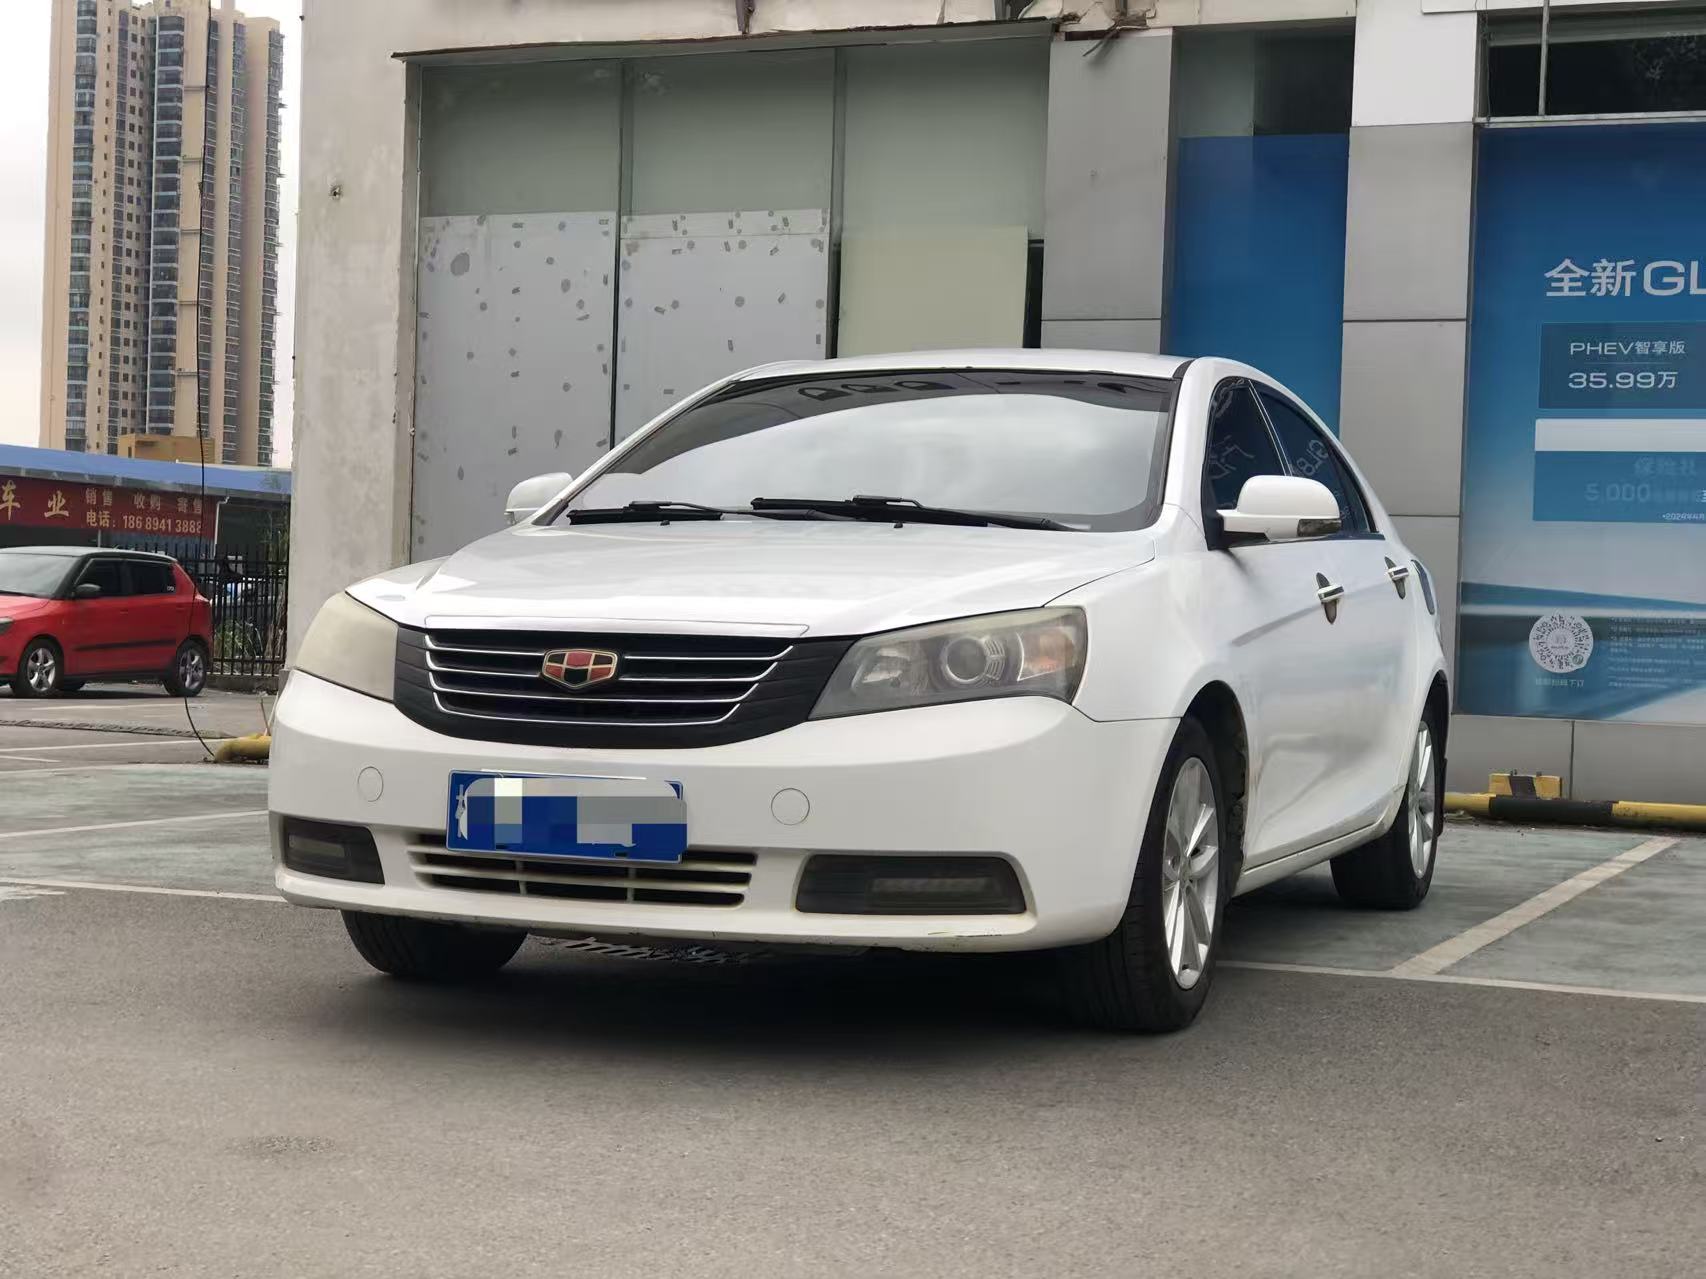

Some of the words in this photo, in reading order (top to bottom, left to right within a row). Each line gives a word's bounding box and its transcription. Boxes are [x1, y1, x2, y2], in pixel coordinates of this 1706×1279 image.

[1568, 371, 1678, 389] 35.99万
[85, 487, 113, 507] 销售
[134, 492, 161, 511] 收购
